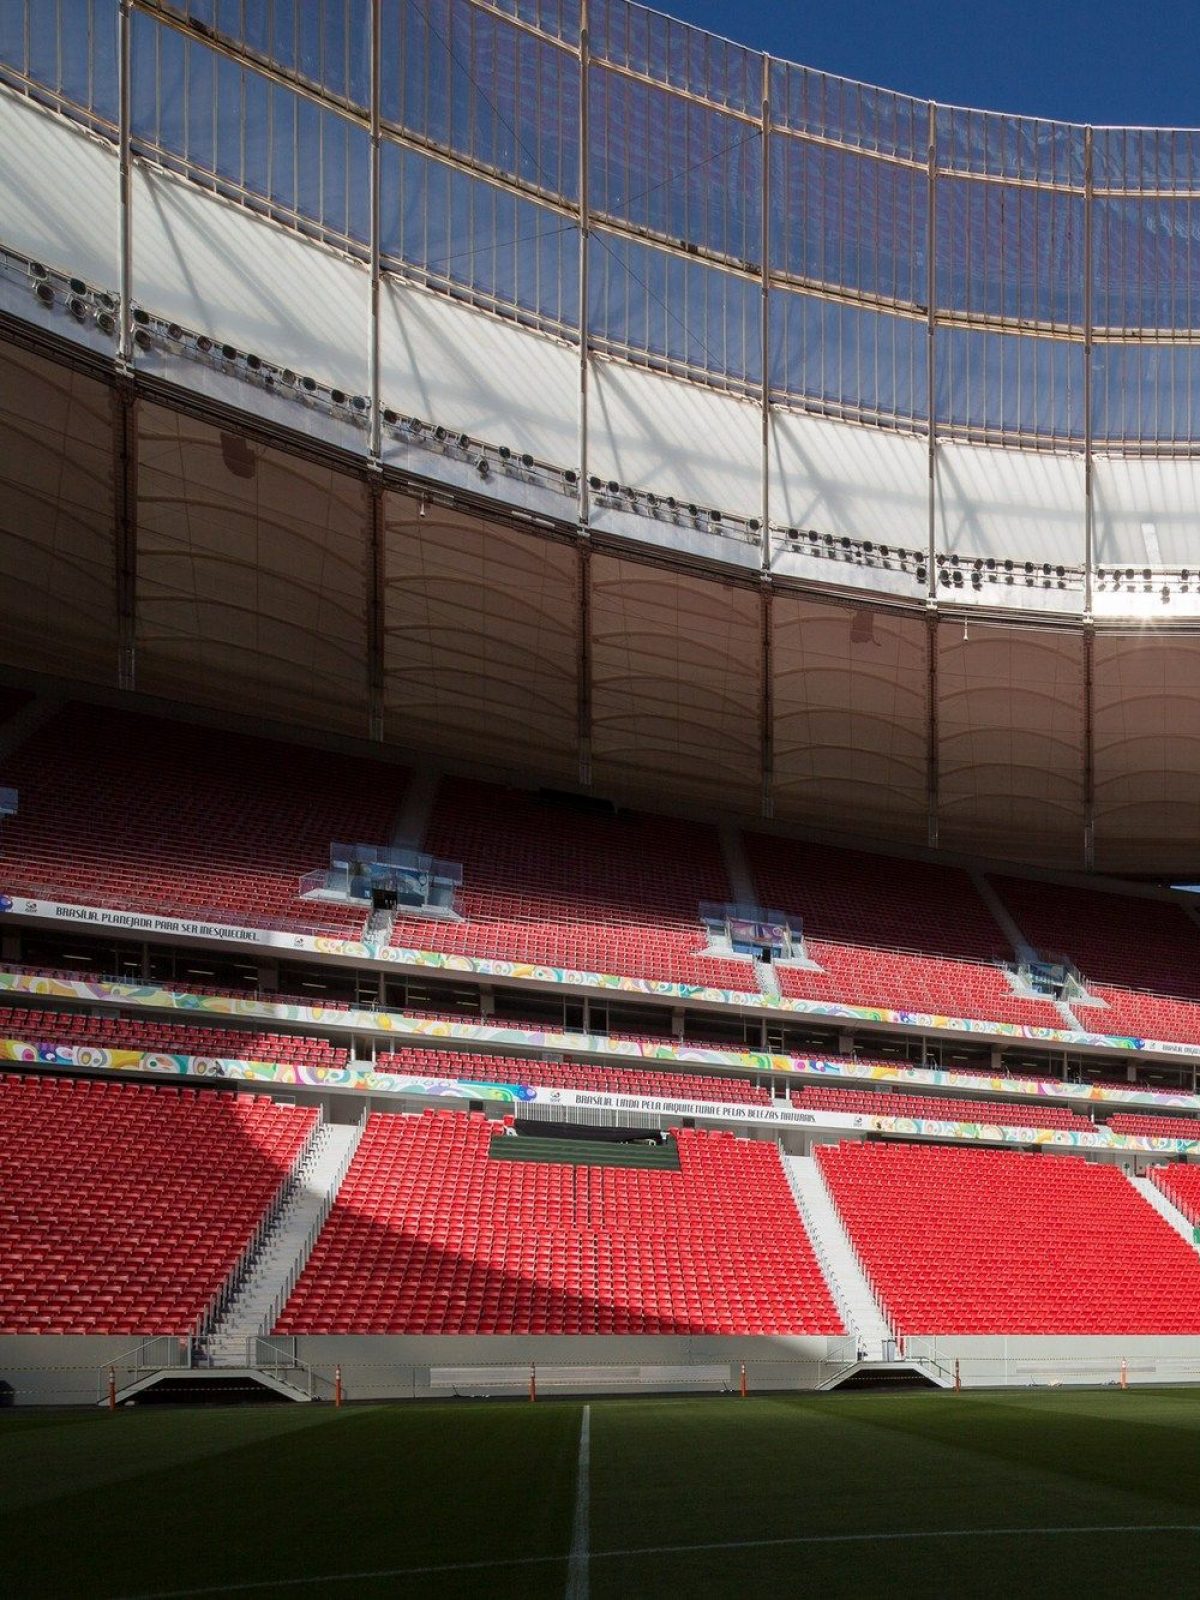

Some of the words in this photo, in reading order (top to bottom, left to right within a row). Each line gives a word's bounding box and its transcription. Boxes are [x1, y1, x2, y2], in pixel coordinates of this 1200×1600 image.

[101, 912, 152, 928] PLANEJADA
[154, 919, 179, 931] PARA
[181, 922, 198, 934] SER
[722, 1106, 746, 1116] PELAS
